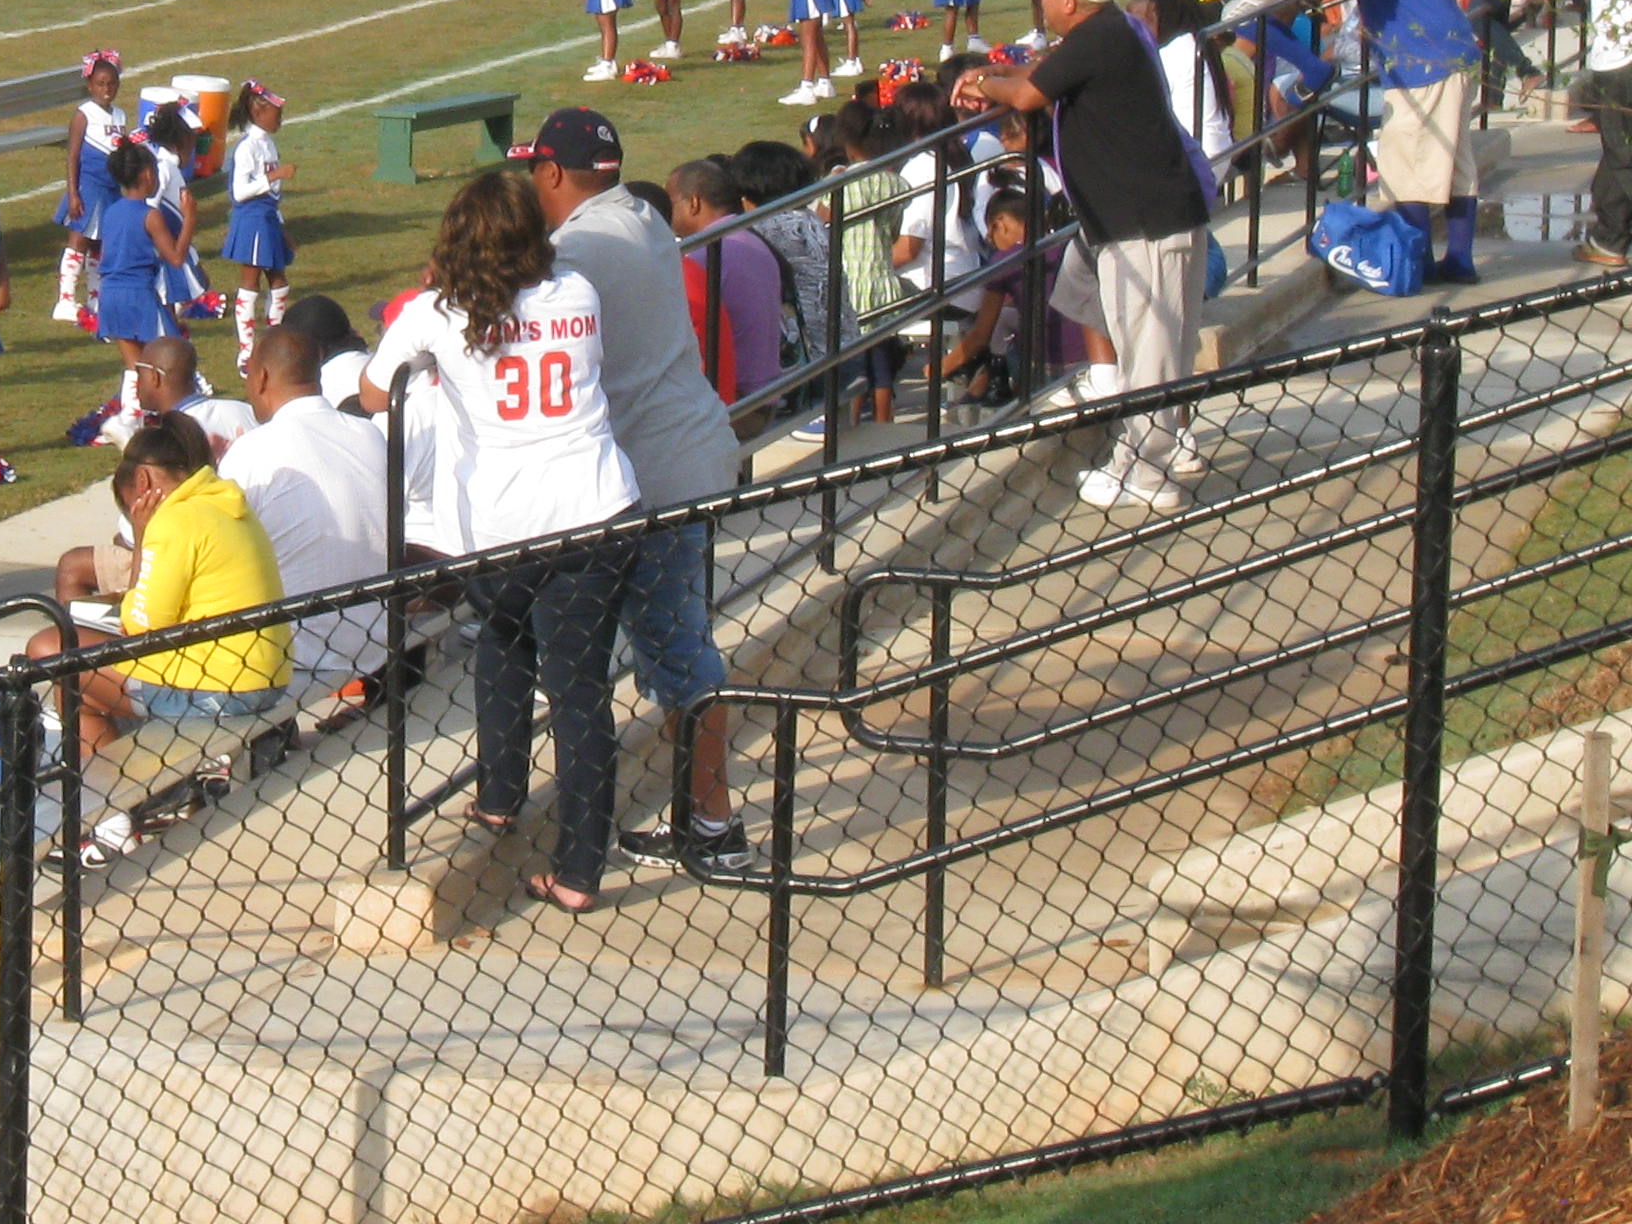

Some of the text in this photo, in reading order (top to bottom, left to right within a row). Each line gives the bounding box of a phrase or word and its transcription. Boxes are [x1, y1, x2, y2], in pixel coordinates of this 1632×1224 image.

[475, 314, 597, 344] AM'S MOM
[495, 351, 572, 421] 30
